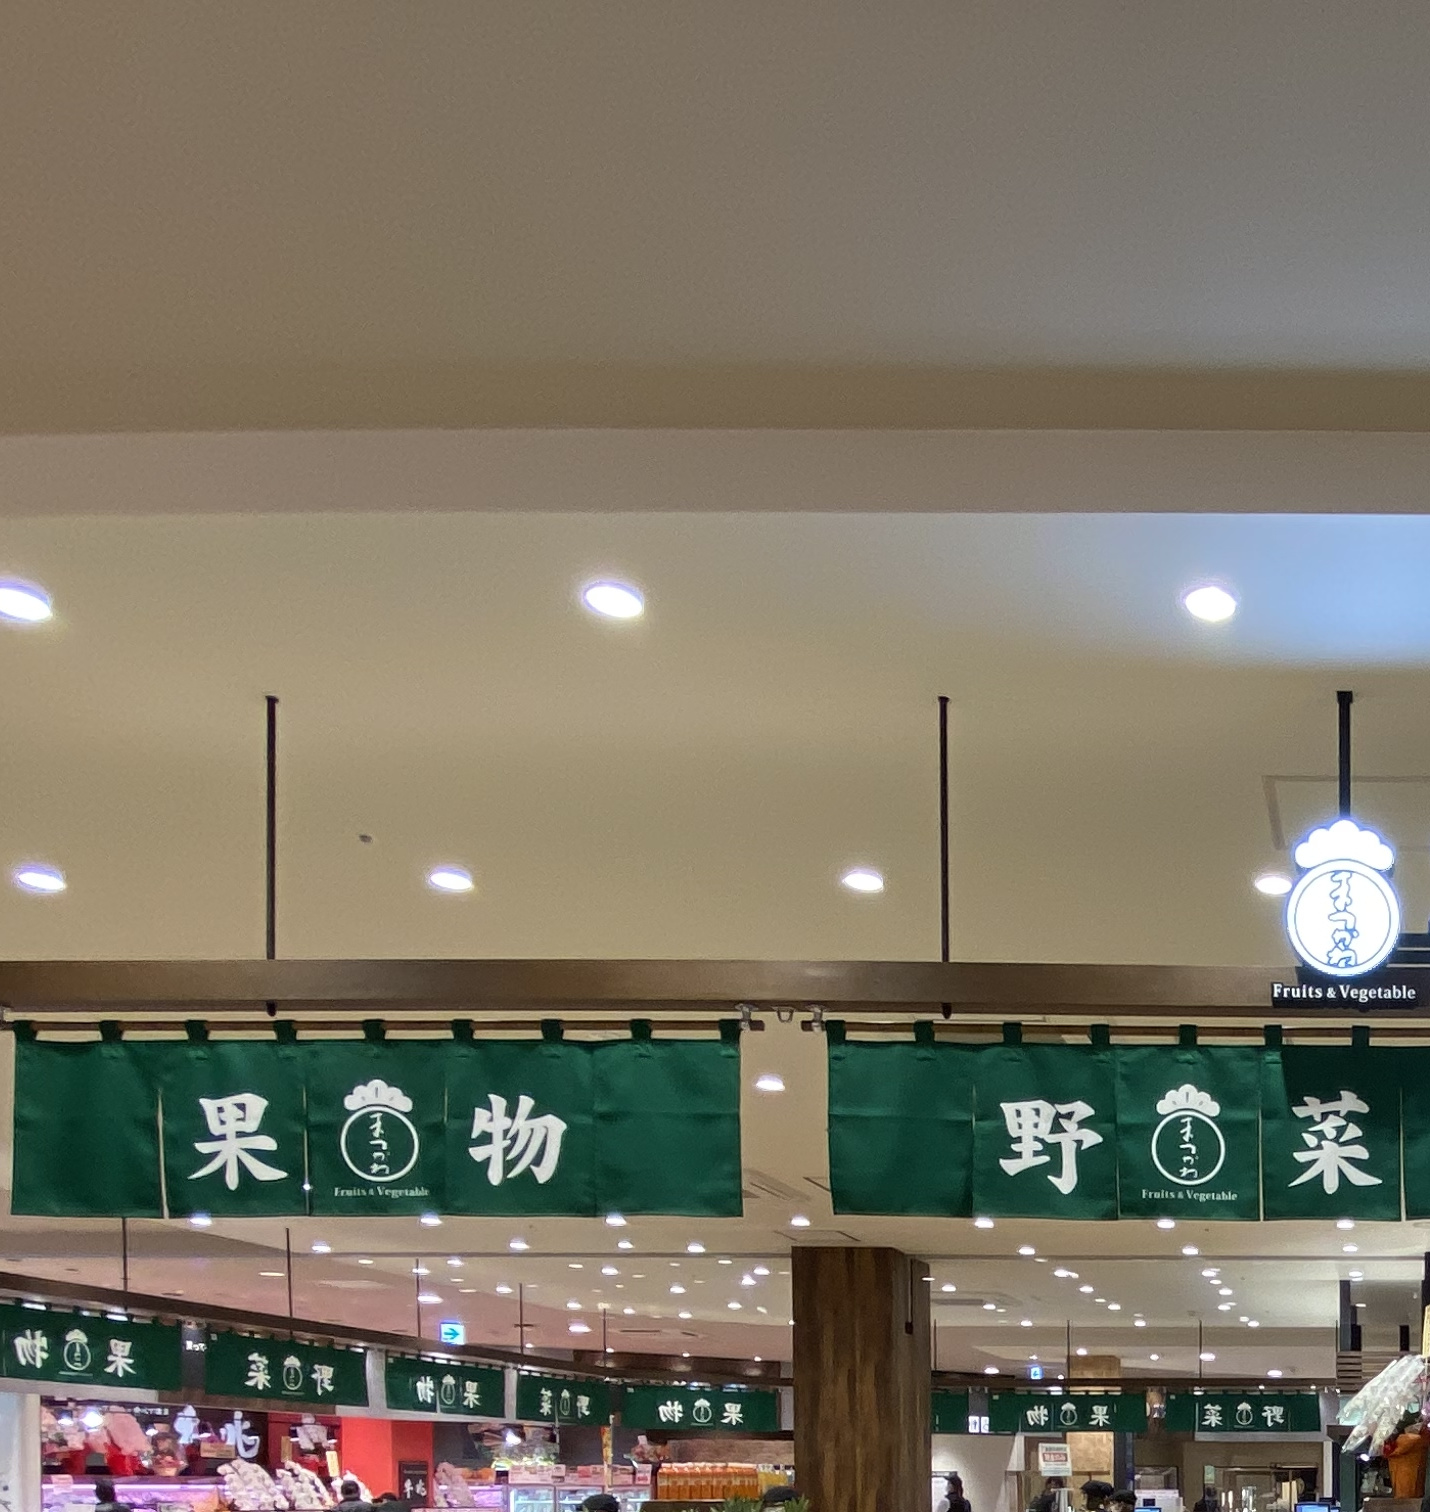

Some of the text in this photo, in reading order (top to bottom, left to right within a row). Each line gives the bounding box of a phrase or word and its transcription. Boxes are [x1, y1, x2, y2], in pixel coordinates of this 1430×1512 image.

[1273, 983, 1416, 1003] Fruits & Vegetable
[334, 1187, 367, 1198] Fruits
[377, 1186, 430, 1199] Vegetable
[1142, 1188, 1175, 1200] Fruits
[1186, 1189, 1238, 1202] Vegetable
